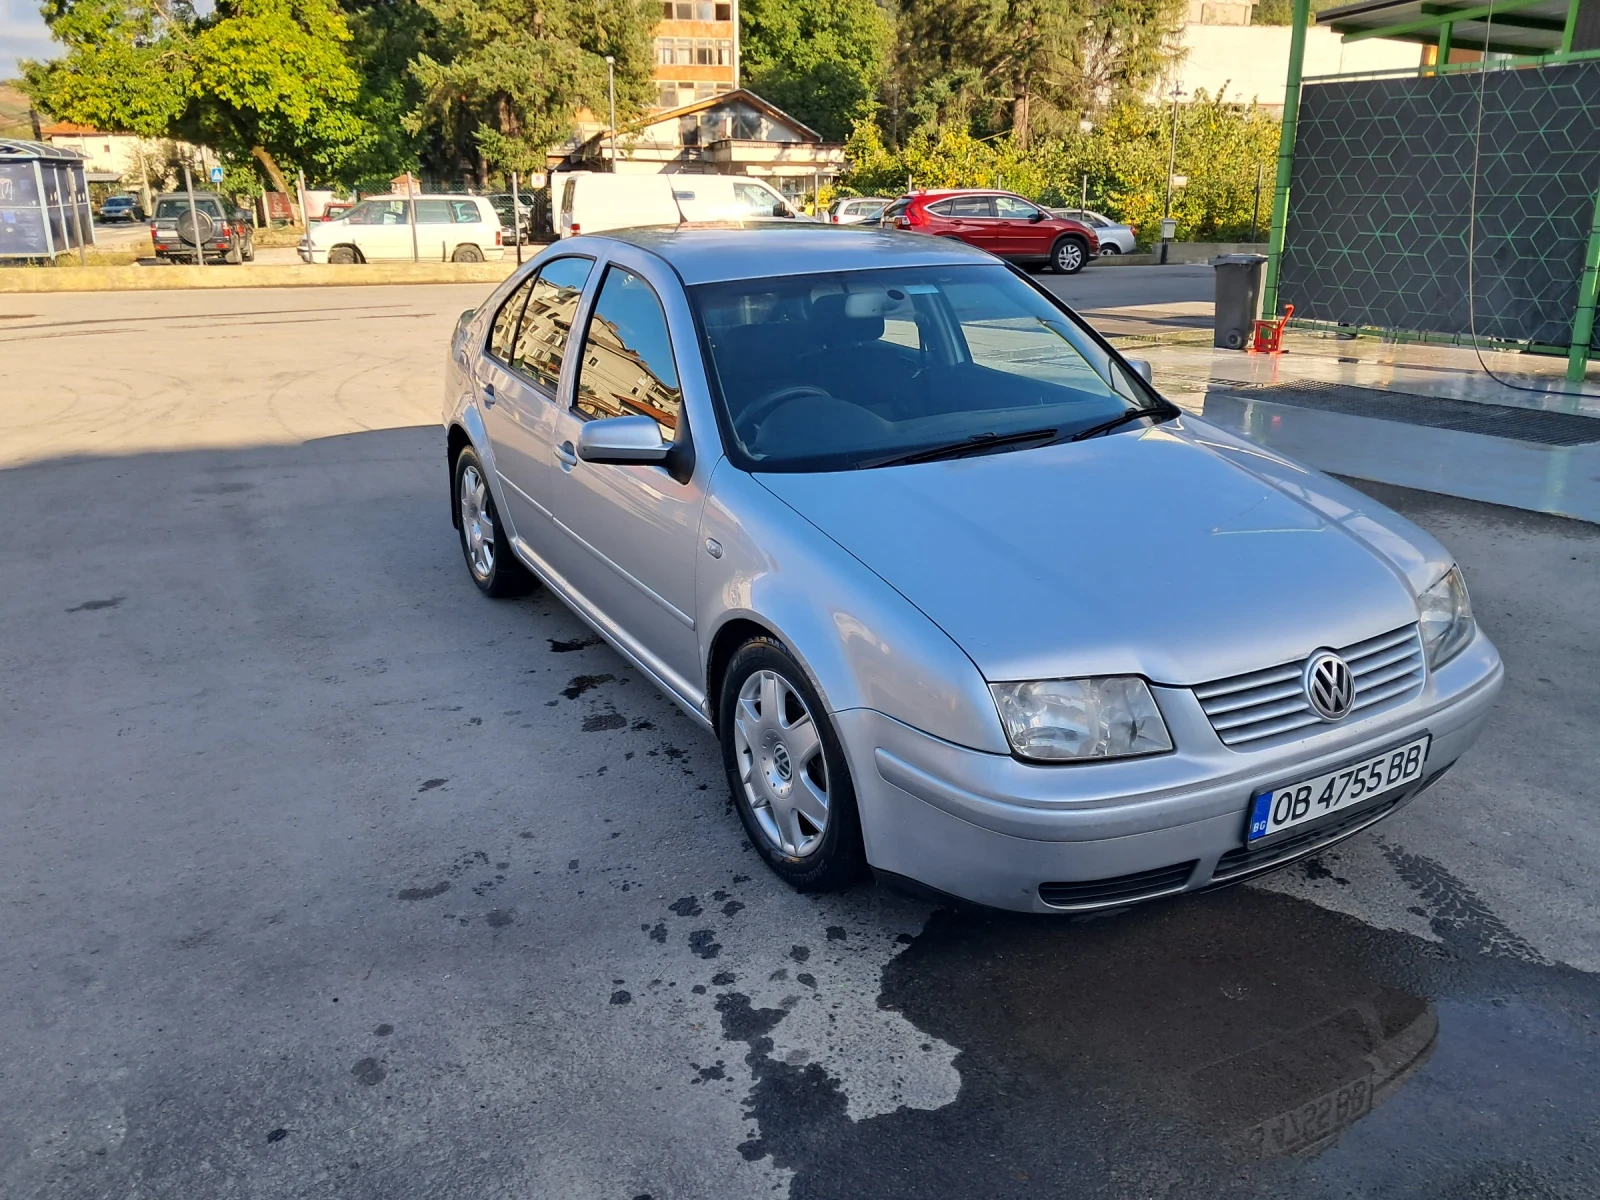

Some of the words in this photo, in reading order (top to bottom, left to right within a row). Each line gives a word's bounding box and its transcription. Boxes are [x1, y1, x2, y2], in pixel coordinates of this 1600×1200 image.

[1272, 785, 1313, 826] OB
[1317, 759, 1386, 809] 4755
[1386, 744, 1422, 786] BB
[1252, 820, 1267, 833] BG
